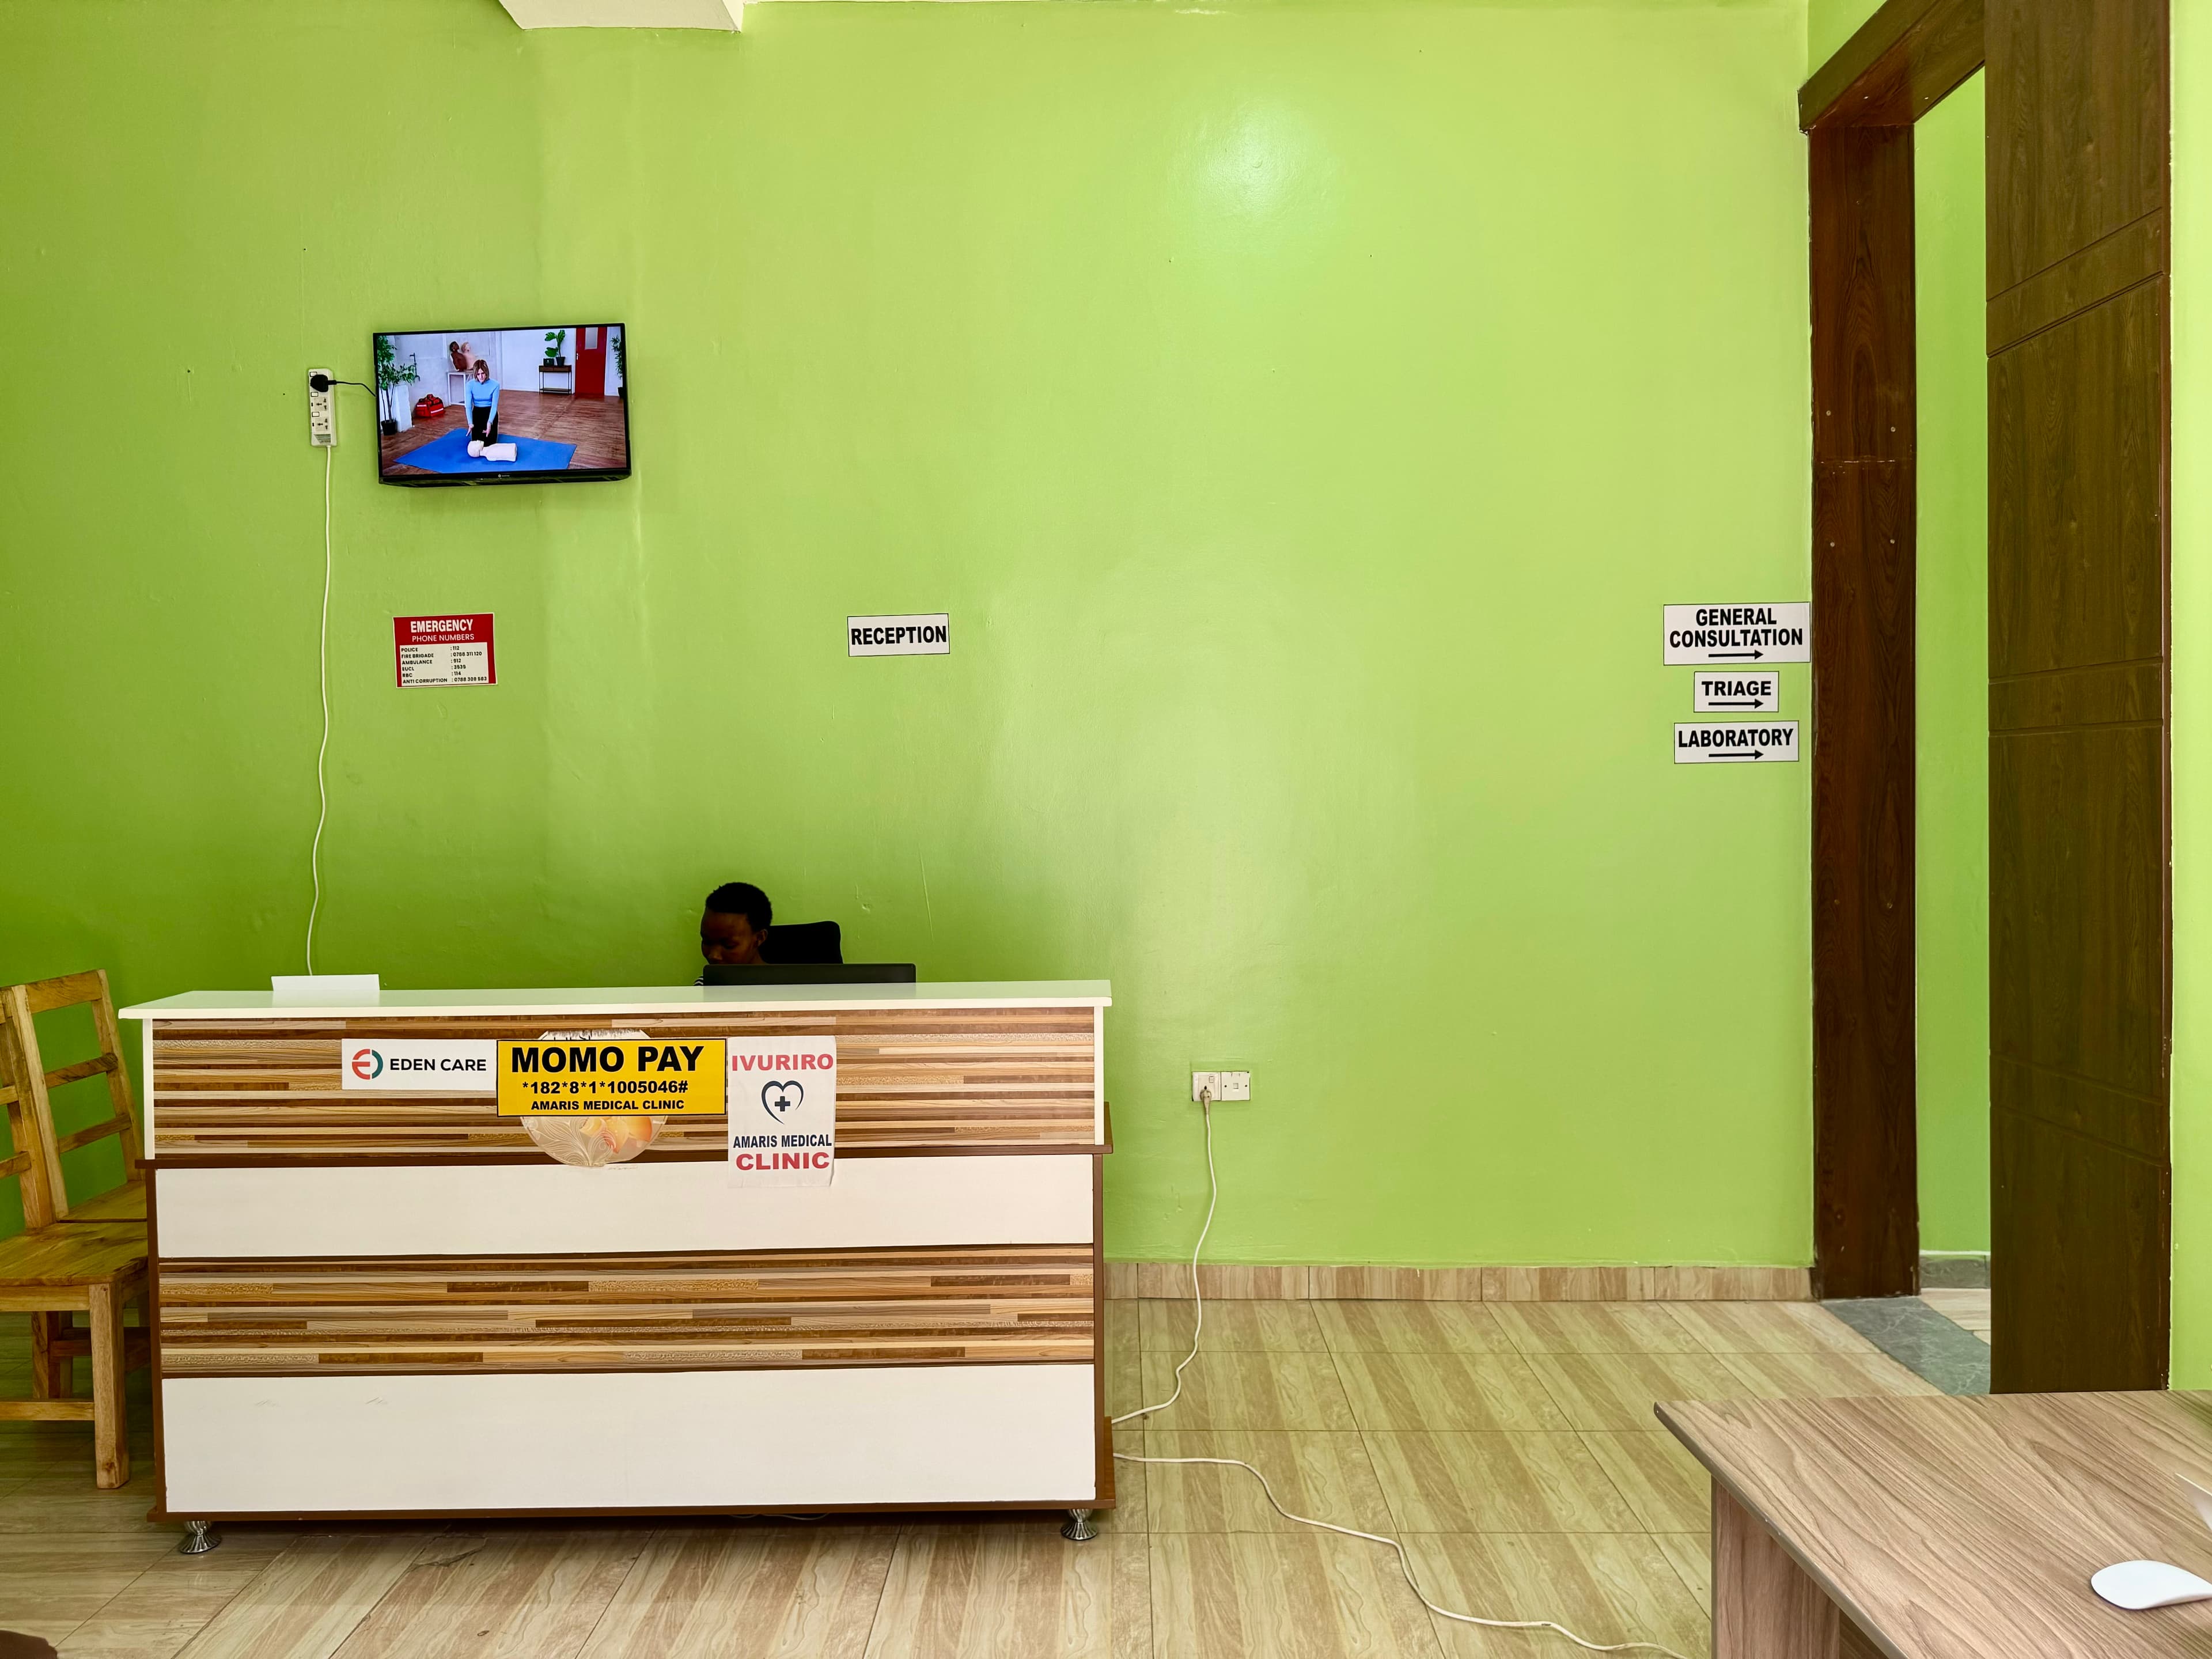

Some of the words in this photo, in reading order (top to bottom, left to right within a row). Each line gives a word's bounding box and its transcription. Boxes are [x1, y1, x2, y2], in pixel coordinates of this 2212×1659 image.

[1696, 608, 1777, 626] GENERAL
[410, 619, 473, 633] EMERGENCY
[851, 626, 946, 645] RECEPTION
[1669, 628, 1802, 648] CONSULTATION
[1701, 681, 1771, 696] TRIAGE
[1678, 728, 1794, 748] LABORATORY
[390, 1058, 435, 1071] EDEN
[440, 1059, 487, 1071] CARE
[512, 1046, 624, 1073] MOMO
[638, 1046, 704, 1071] PAY
[732, 1054, 834, 1071] IVURIRO
[531, 1100, 579, 1111] AMARIS
[583, 1100, 638, 1110] MEDICAL
[642, 1100, 684, 1109] CLINIC
[733, 1135, 777, 1148] AMARIS
[781, 1134, 832, 1147] MEDICAL
[736, 1152, 830, 1171] CLINIC
